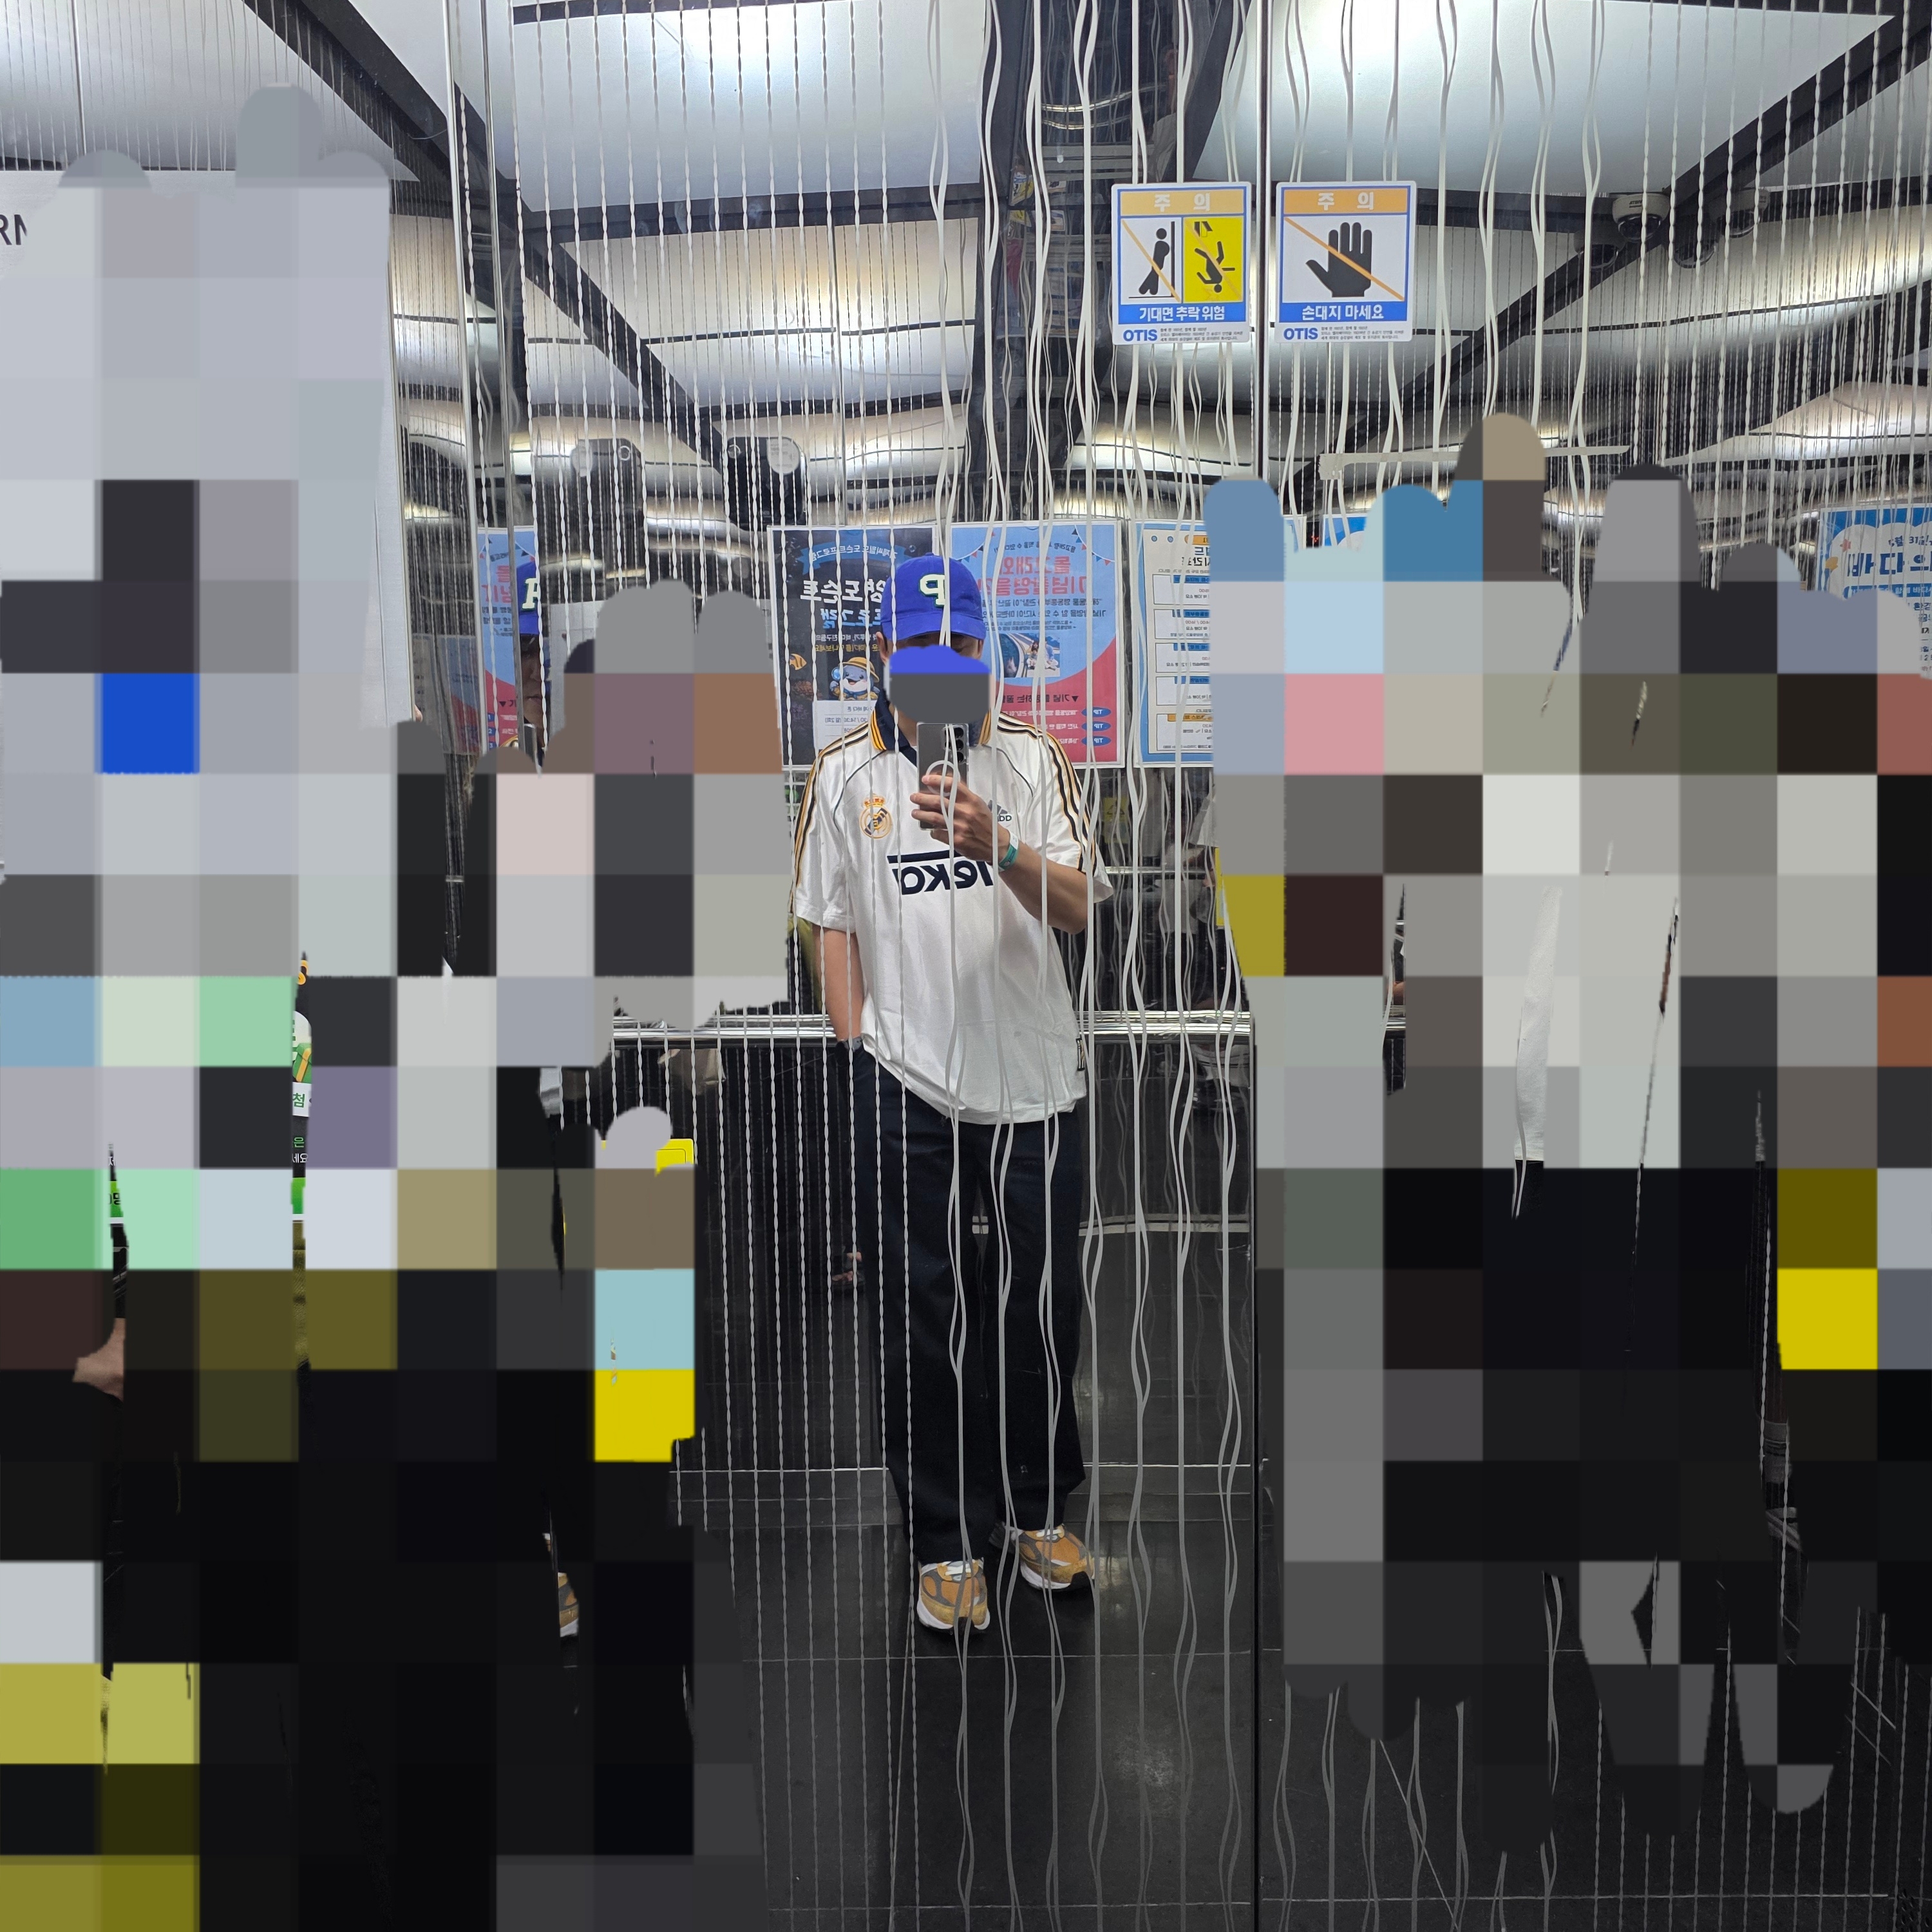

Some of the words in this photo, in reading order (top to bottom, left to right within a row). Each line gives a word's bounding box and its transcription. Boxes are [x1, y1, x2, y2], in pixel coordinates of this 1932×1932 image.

[1139, 307, 1173, 322] 기대면
[1176, 305, 1200, 321] 추락
[1202, 305, 1225, 321] 위험
[1302, 305, 1341, 321] 손대지
[1345, 305, 1384, 320] 마세요
[1122, 328, 1158, 342] OTIS
[1283, 327, 1318, 341] OTIS
